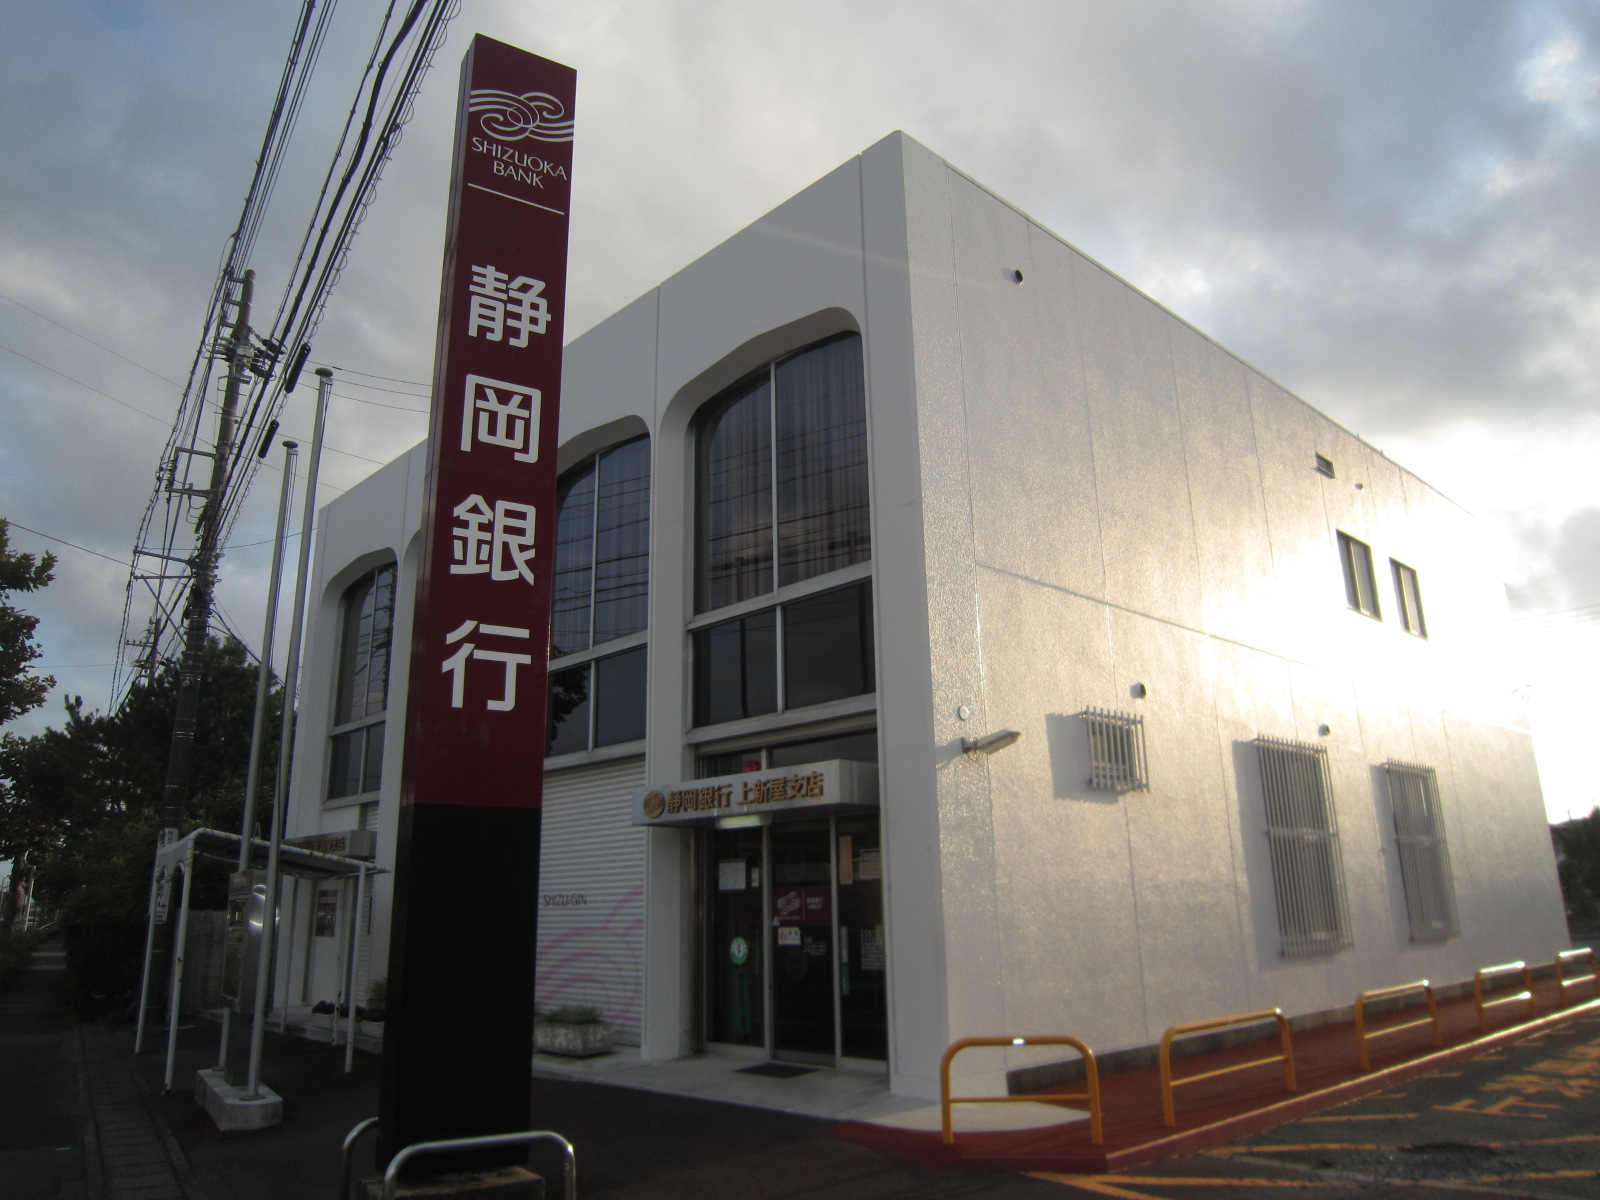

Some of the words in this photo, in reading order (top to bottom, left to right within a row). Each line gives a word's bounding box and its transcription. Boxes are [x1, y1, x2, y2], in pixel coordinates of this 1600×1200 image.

[472, 137, 567, 180] SHIZUOKA
[493, 160, 544, 189] BANK
[442, 264, 551, 712] 静岡銀行
[667, 784, 732, 814] 静岡銀行
[736, 771, 824, 804] 上新屋支店
